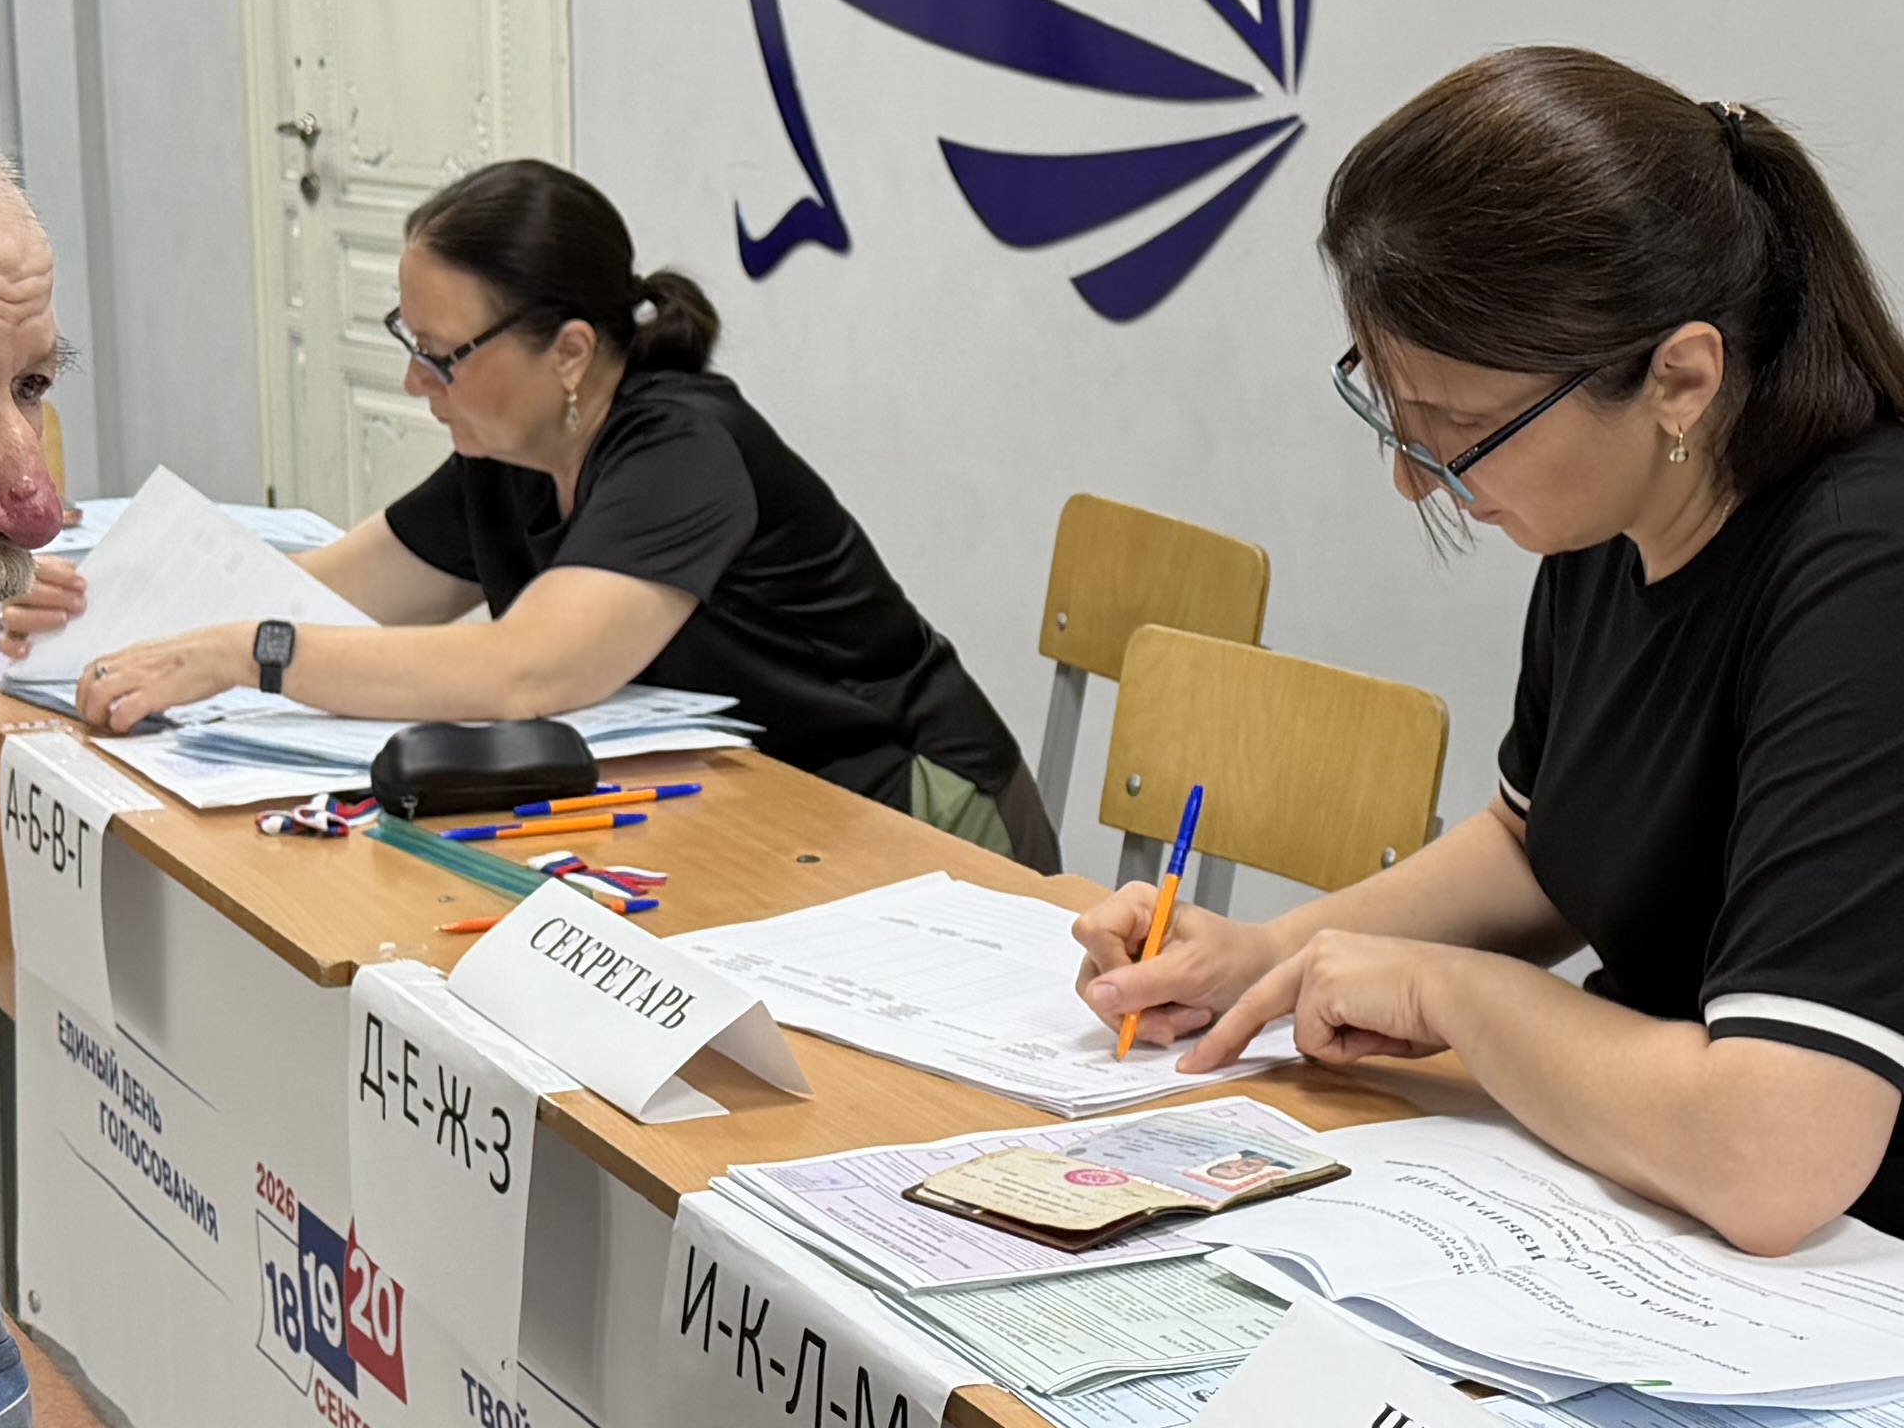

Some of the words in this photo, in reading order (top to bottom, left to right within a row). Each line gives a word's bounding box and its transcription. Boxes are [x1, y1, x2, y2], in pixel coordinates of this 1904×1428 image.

[5, 766, 92, 889] А-Б-В-Г
[529, 915, 698, 1032] СЕКРЕТАРЬ
[57, 1009, 121, 1098] ЕДИНЫЙ
[122, 1069, 164, 1135] ДЕНЬ
[360, 1011, 512, 1195] Д-Е-Ж-З
[99, 1100, 219, 1244] ГОЛОСОВАНИЯ
[255, 1162, 296, 1224] 2026
[1395, 1174, 1547, 1262] ИЗБИРАТЕЛЕЙ
[265, 1259, 303, 1354] 18
[303, 1251, 344, 1349] 19
[349, 1247, 398, 1357] 20
[1639, 1299, 1719, 1329] КНИГА
